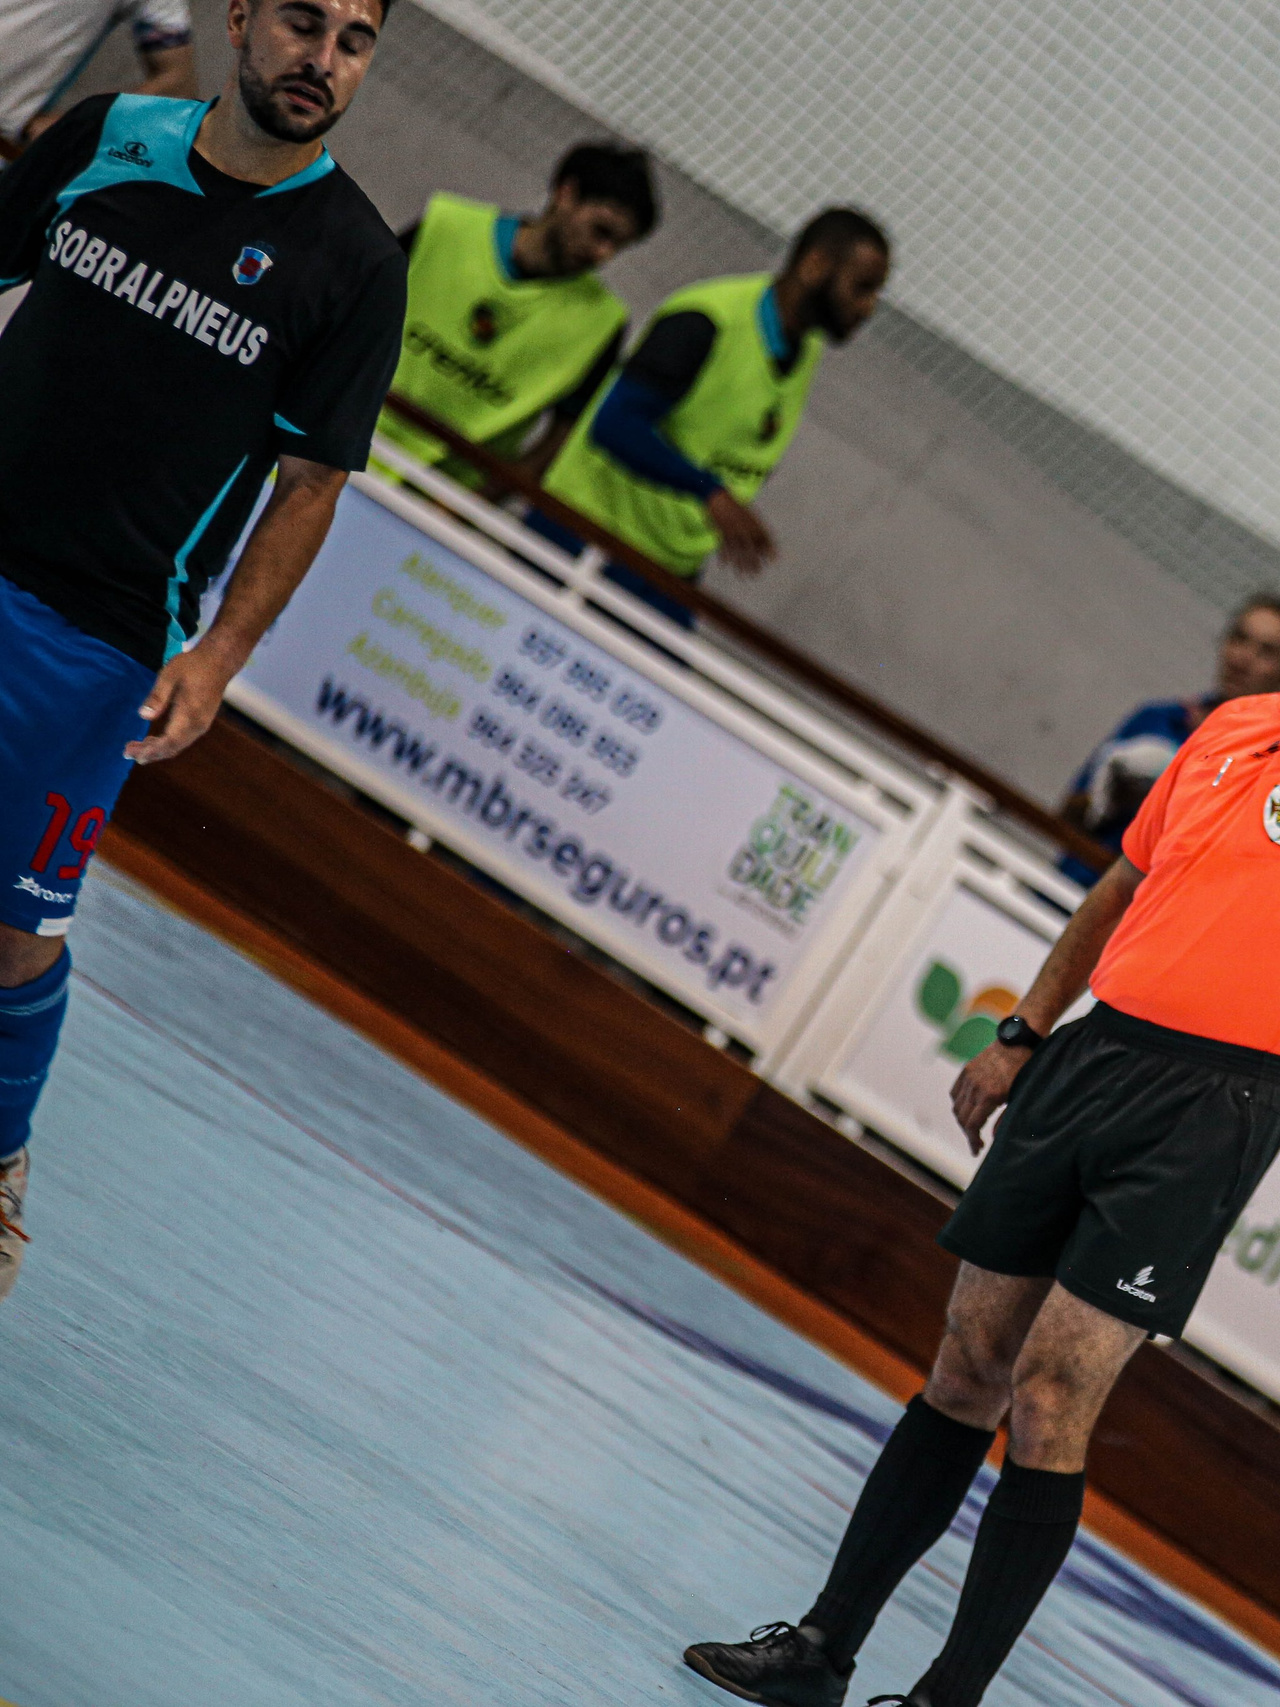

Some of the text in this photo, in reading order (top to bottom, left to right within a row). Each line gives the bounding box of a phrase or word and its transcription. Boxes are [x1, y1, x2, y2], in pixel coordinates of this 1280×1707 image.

[48, 219, 270, 366] SOBRALPNEUS
[29, 791, 106, 880] 19
[315, 676, 778, 1004] www.mbrseguros.pt
